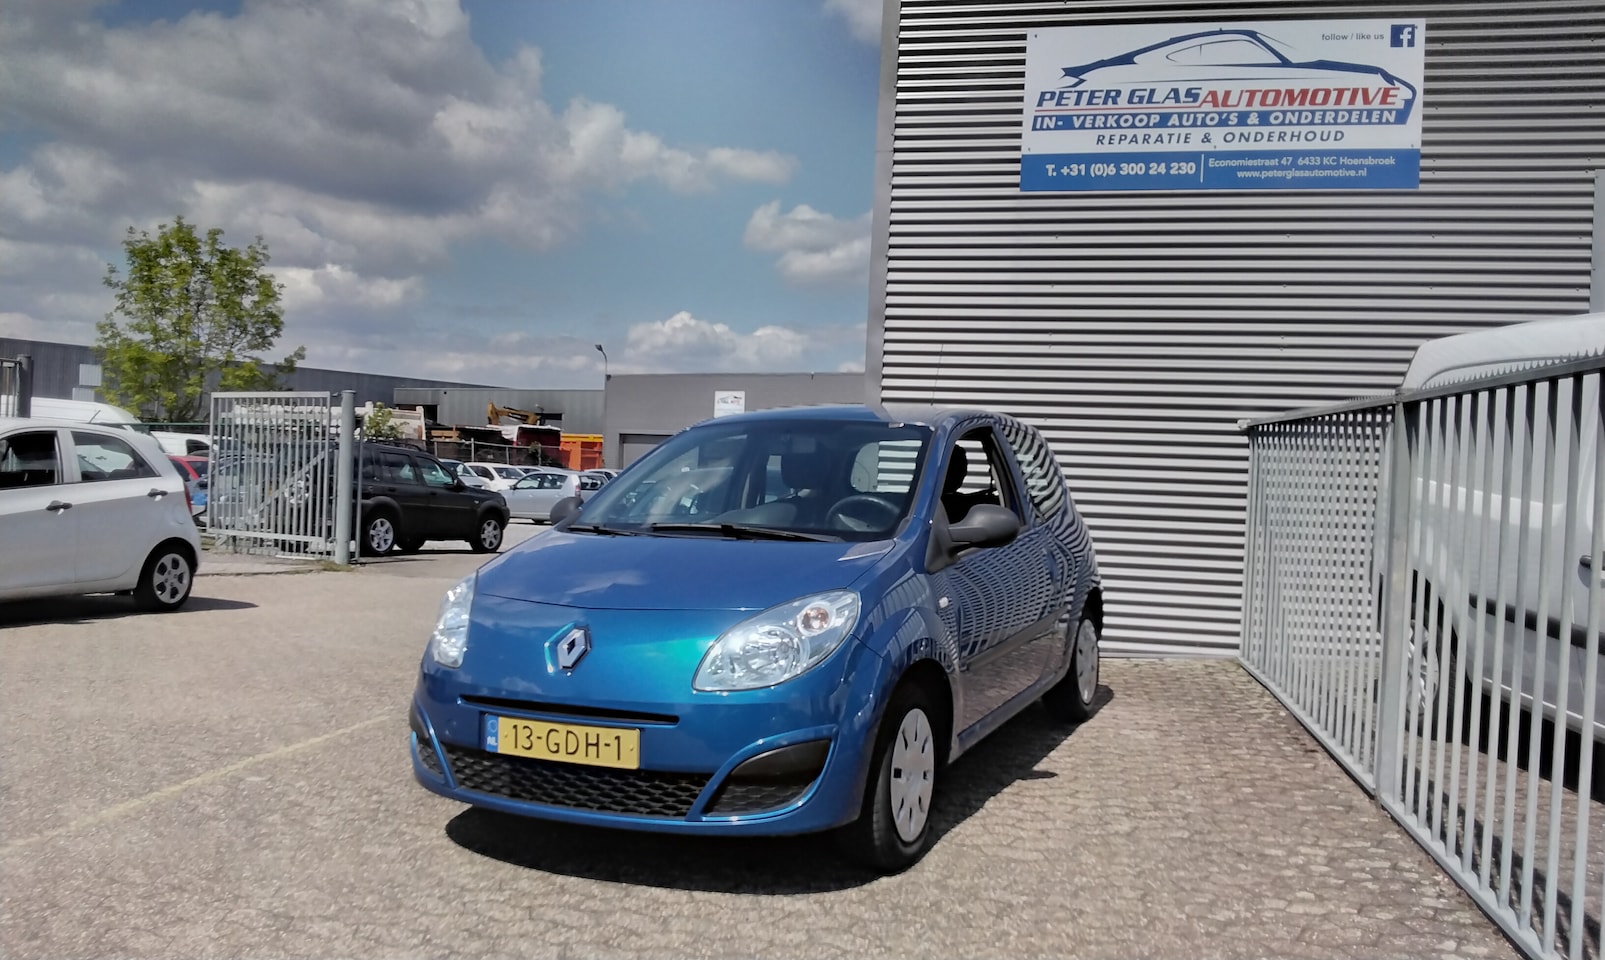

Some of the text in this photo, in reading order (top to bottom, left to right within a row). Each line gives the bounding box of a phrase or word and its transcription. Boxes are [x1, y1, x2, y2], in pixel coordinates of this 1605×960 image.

[1036, 89, 1122, 107] PETER
[1035, 110, 1396, 129] IN- VERKOOP AUTO'S & ONDERDELEN
[1096, 130, 1345, 145] REPARATIE & ONDERHOUD
[1208, 156, 1395, 167] Economiestraat 47 6433 KC Hoensbroek
[1045, 162, 1196, 178] T. +31 (0)6 300 24 230
[1237, 168, 1367, 180] www.peterglasautomotive.nl
[486, 735, 498, 746] NL
[512, 724, 621, 761] 13-GDH-1
